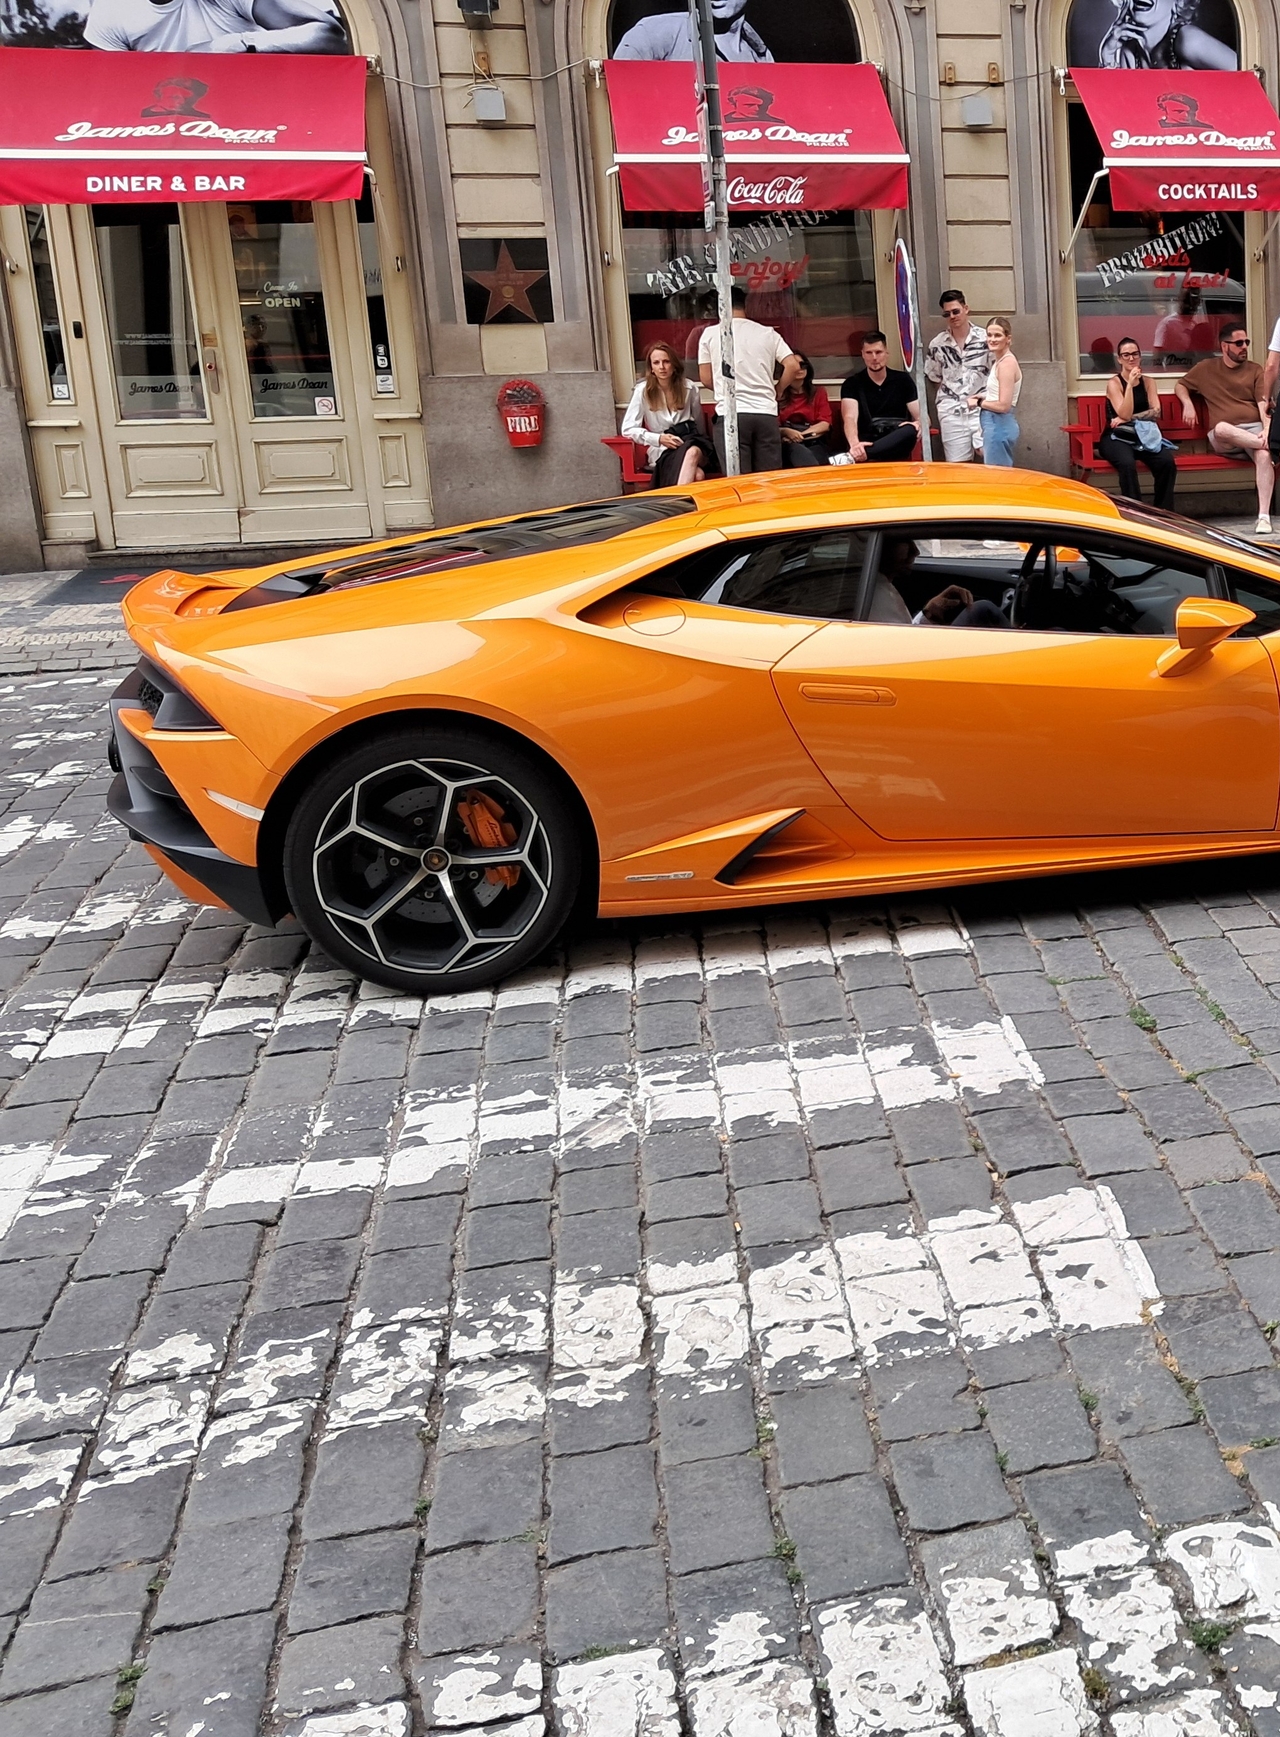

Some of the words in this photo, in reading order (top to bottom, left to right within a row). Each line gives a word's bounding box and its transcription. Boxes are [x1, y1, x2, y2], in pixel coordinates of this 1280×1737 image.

[54, 122, 176, 142] James
[179, 120, 278, 141] Dean
[661, 126, 763, 145] Jaes
[765, 126, 847, 143] Dean
[1110, 130, 1198, 149] James
[1199, 131, 1273, 148] Dean
[86, 176, 163, 192] DINER
[170, 176, 188, 192] &
[194, 175, 245, 191] BAR
[727, 176, 808, 205] Coca-Cola
[1157, 183, 1258, 200] COCKTAILS
[1096, 211, 1223, 288] PROHIBITION!
[730, 253, 811, 289] enjoy!
[1154, 273, 1177, 289] at
[1182, 268, 1229, 289] last!
[287, 280, 299, 291] In
[264, 297, 301, 308] OPEN
[128, 381, 163, 396] James
[260, 377, 297, 394] James
[297, 377, 328, 390] Dean
[506, 415, 539, 433] FIRE
